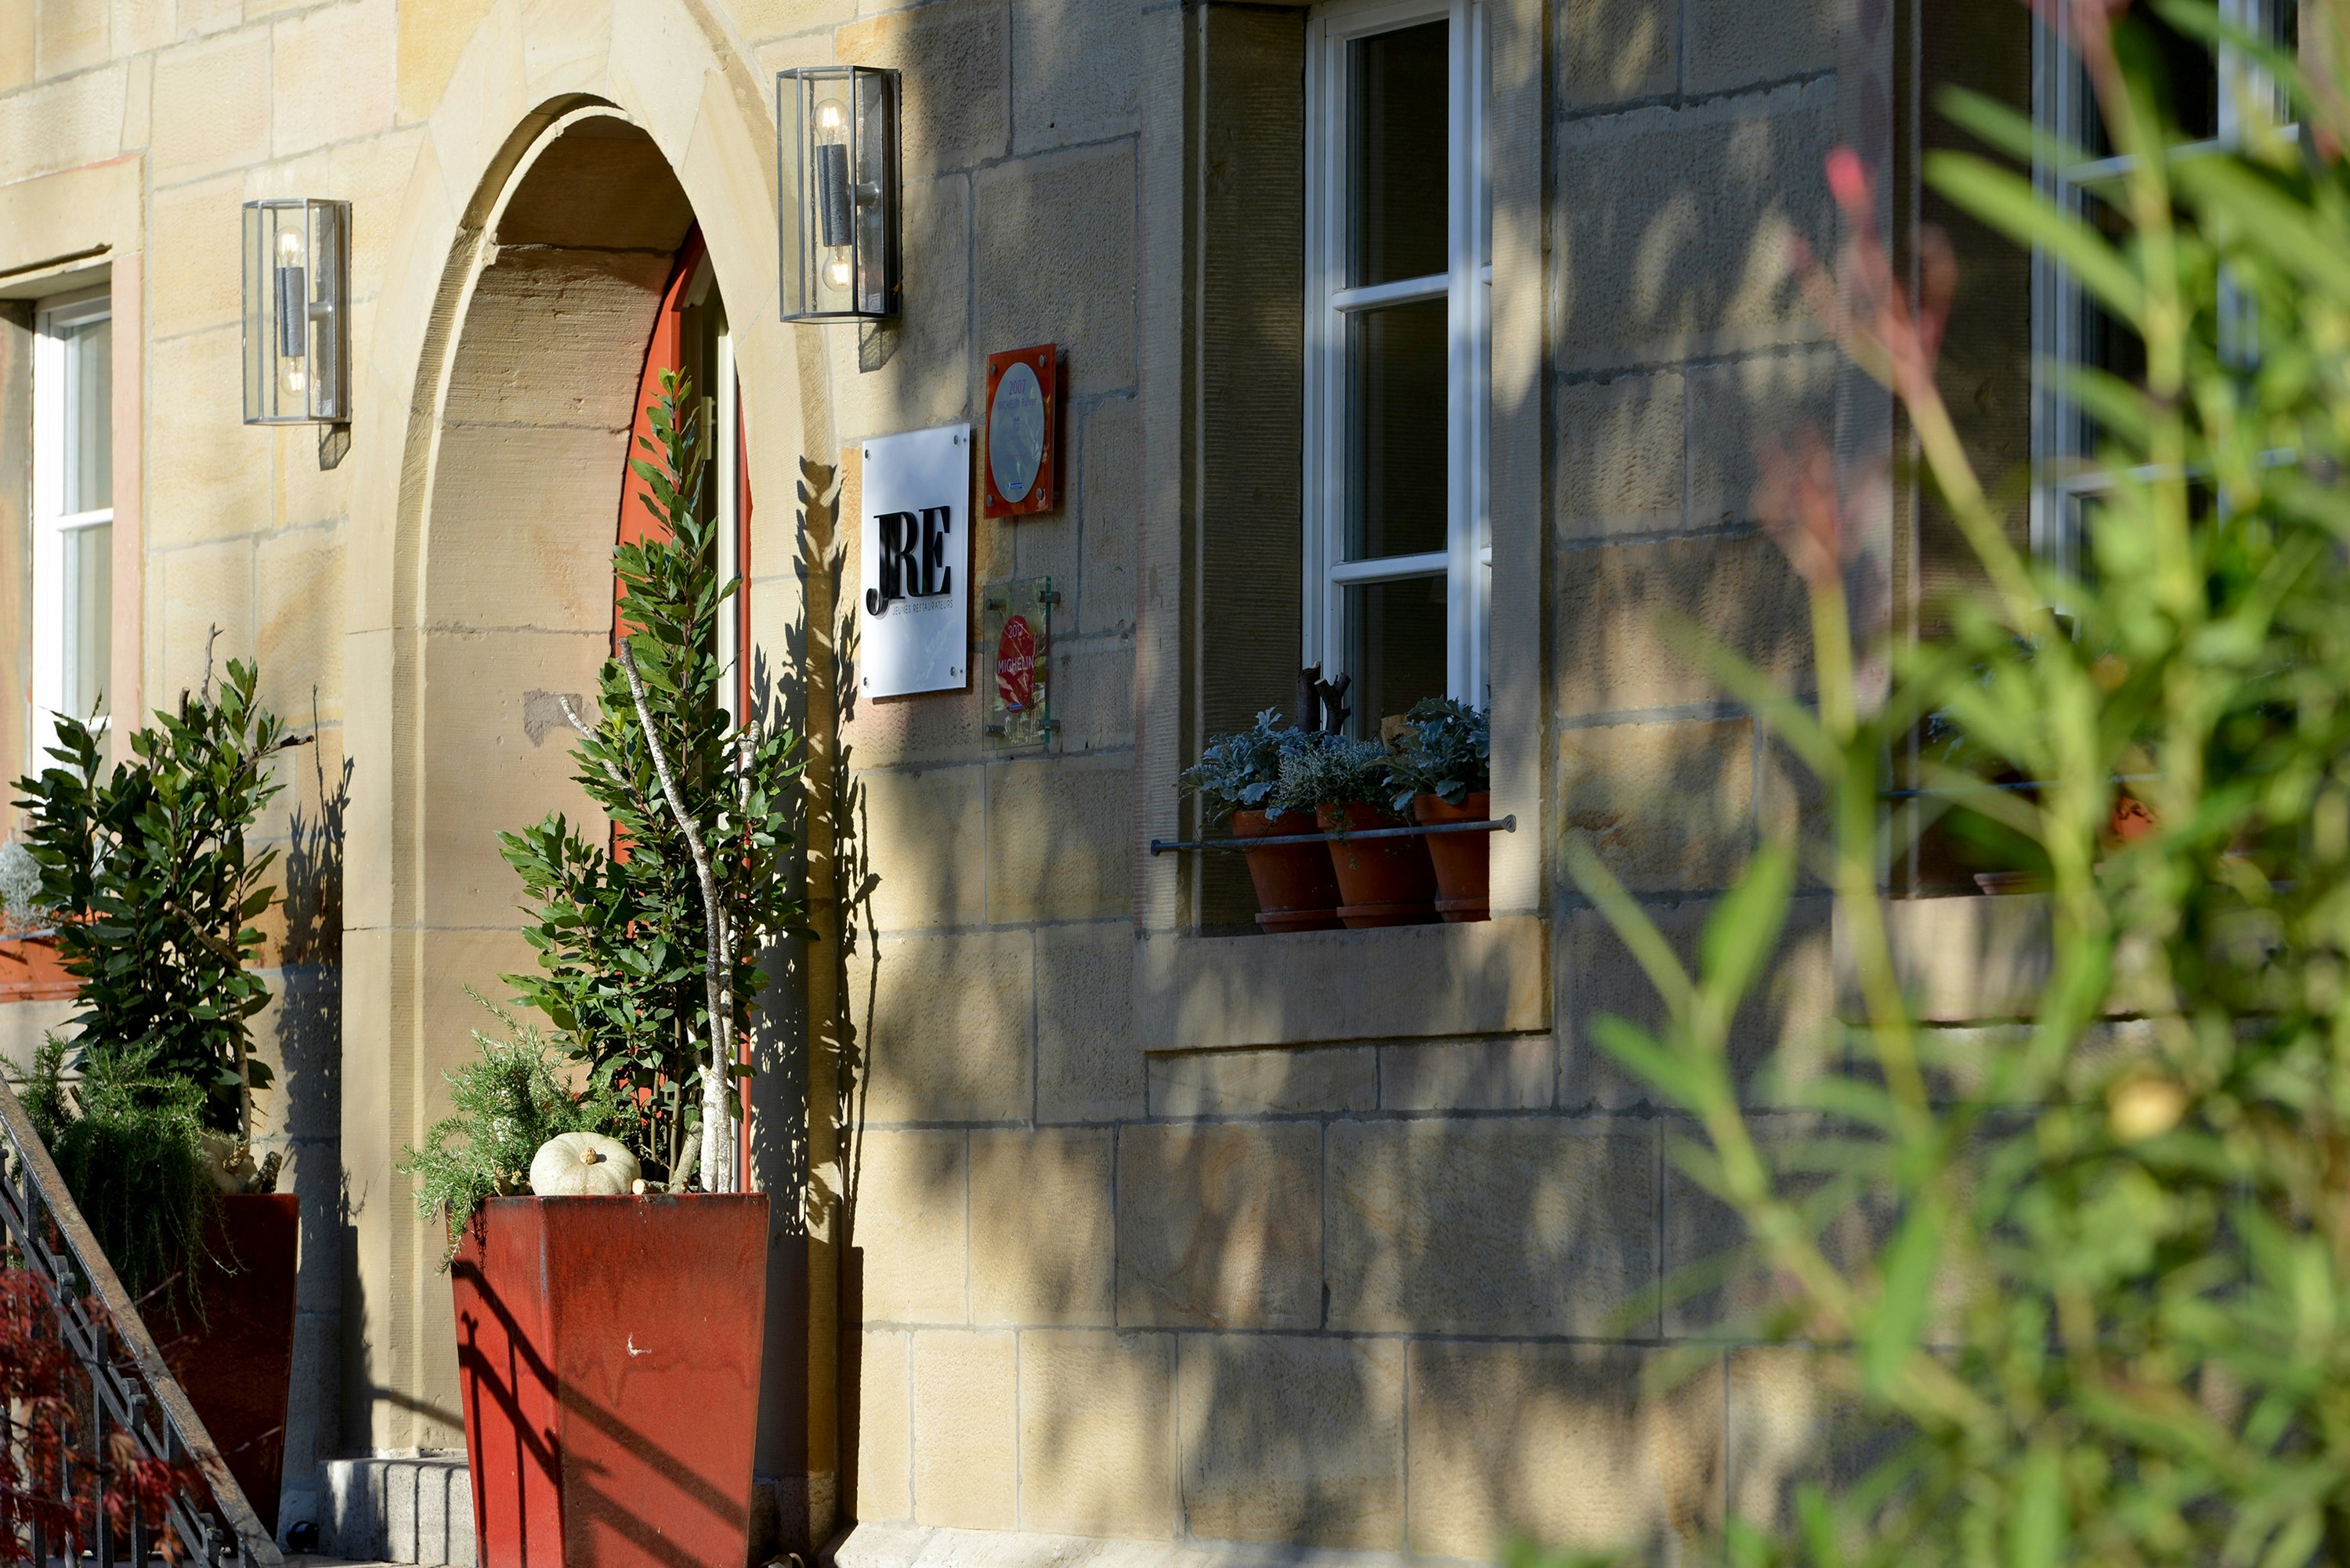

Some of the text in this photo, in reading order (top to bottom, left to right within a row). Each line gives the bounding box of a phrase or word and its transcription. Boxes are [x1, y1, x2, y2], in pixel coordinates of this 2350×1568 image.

[1009, 379, 1026, 395] 2007
[866, 506, 951, 616] JRE
[893, 599, 953, 616] JEUNES RESTAURATEURS
[998, 656, 1034, 674] MICHELIN
